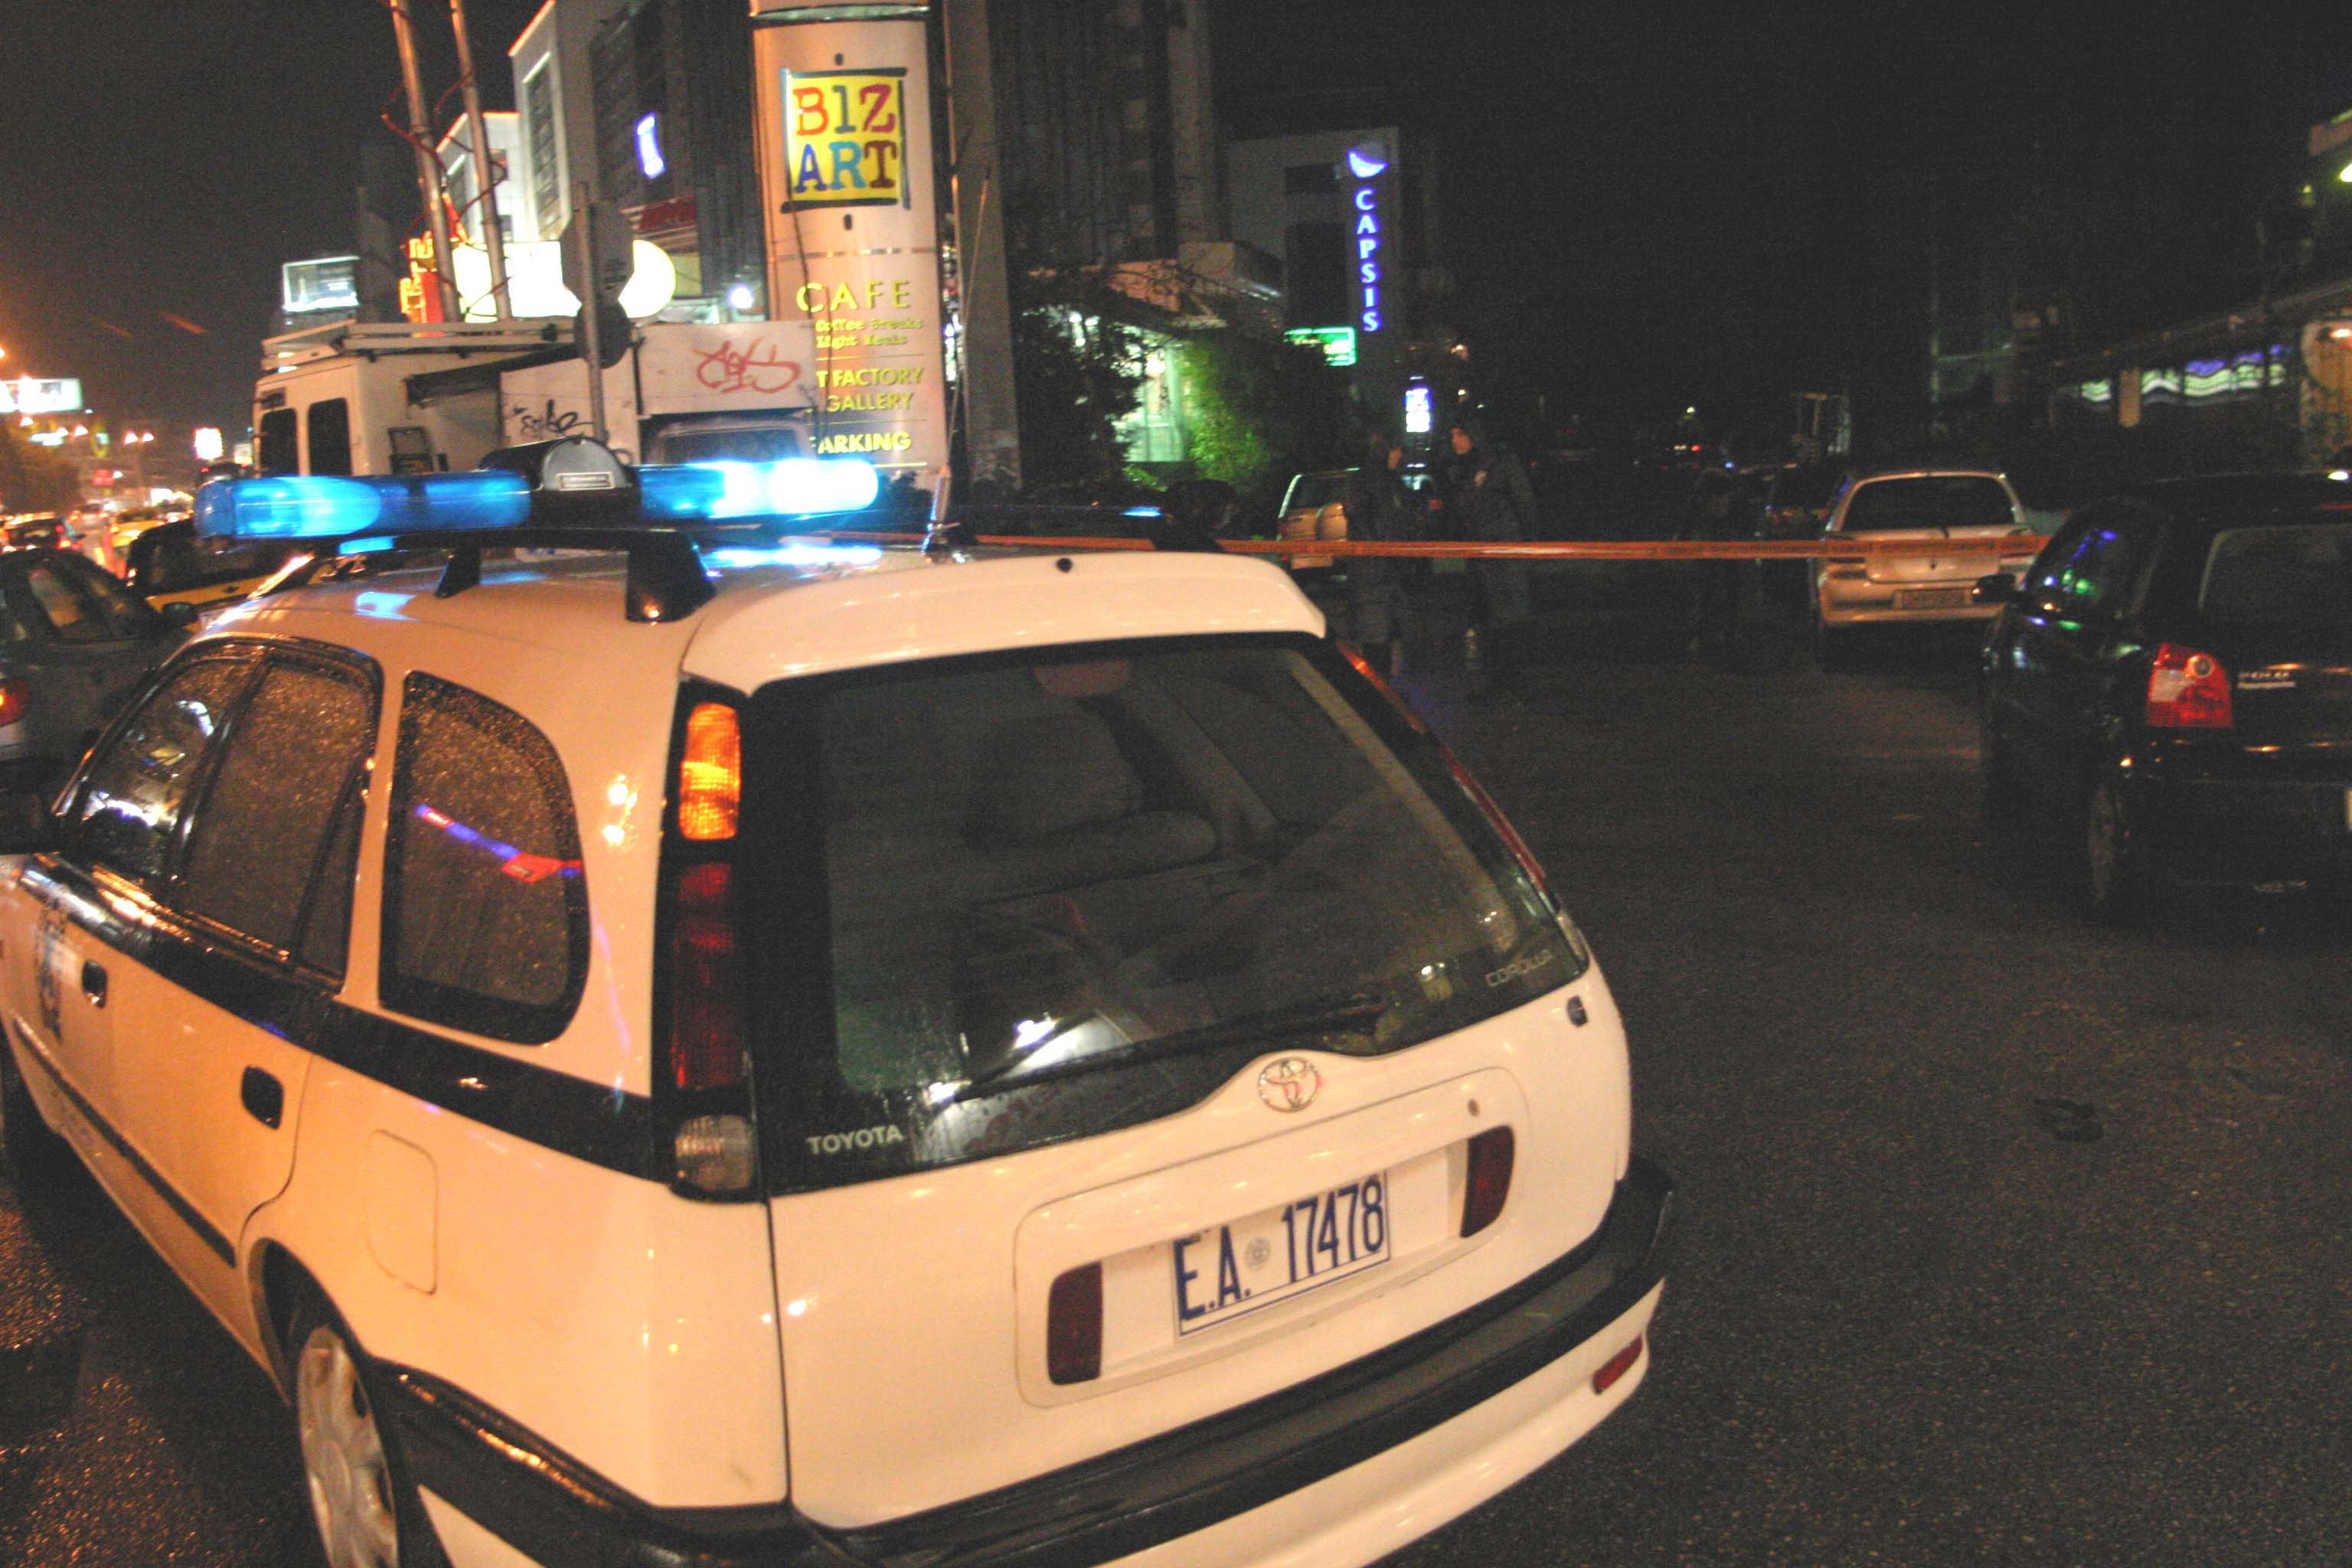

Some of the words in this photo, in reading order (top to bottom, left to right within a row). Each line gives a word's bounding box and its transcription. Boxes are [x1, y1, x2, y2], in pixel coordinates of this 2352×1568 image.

[792, 83, 896, 136] BIZ
[794, 140, 898, 193] ART
[1355, 188, 1381, 332] CAPSIS
[795, 280, 911, 313] CAFE
[831, 368, 924, 387] FACTORY
[809, 431, 913, 455] ARKING
[805, 1125, 903, 1155] TOYOTA
[1282, 1174, 1384, 1284] 17478
